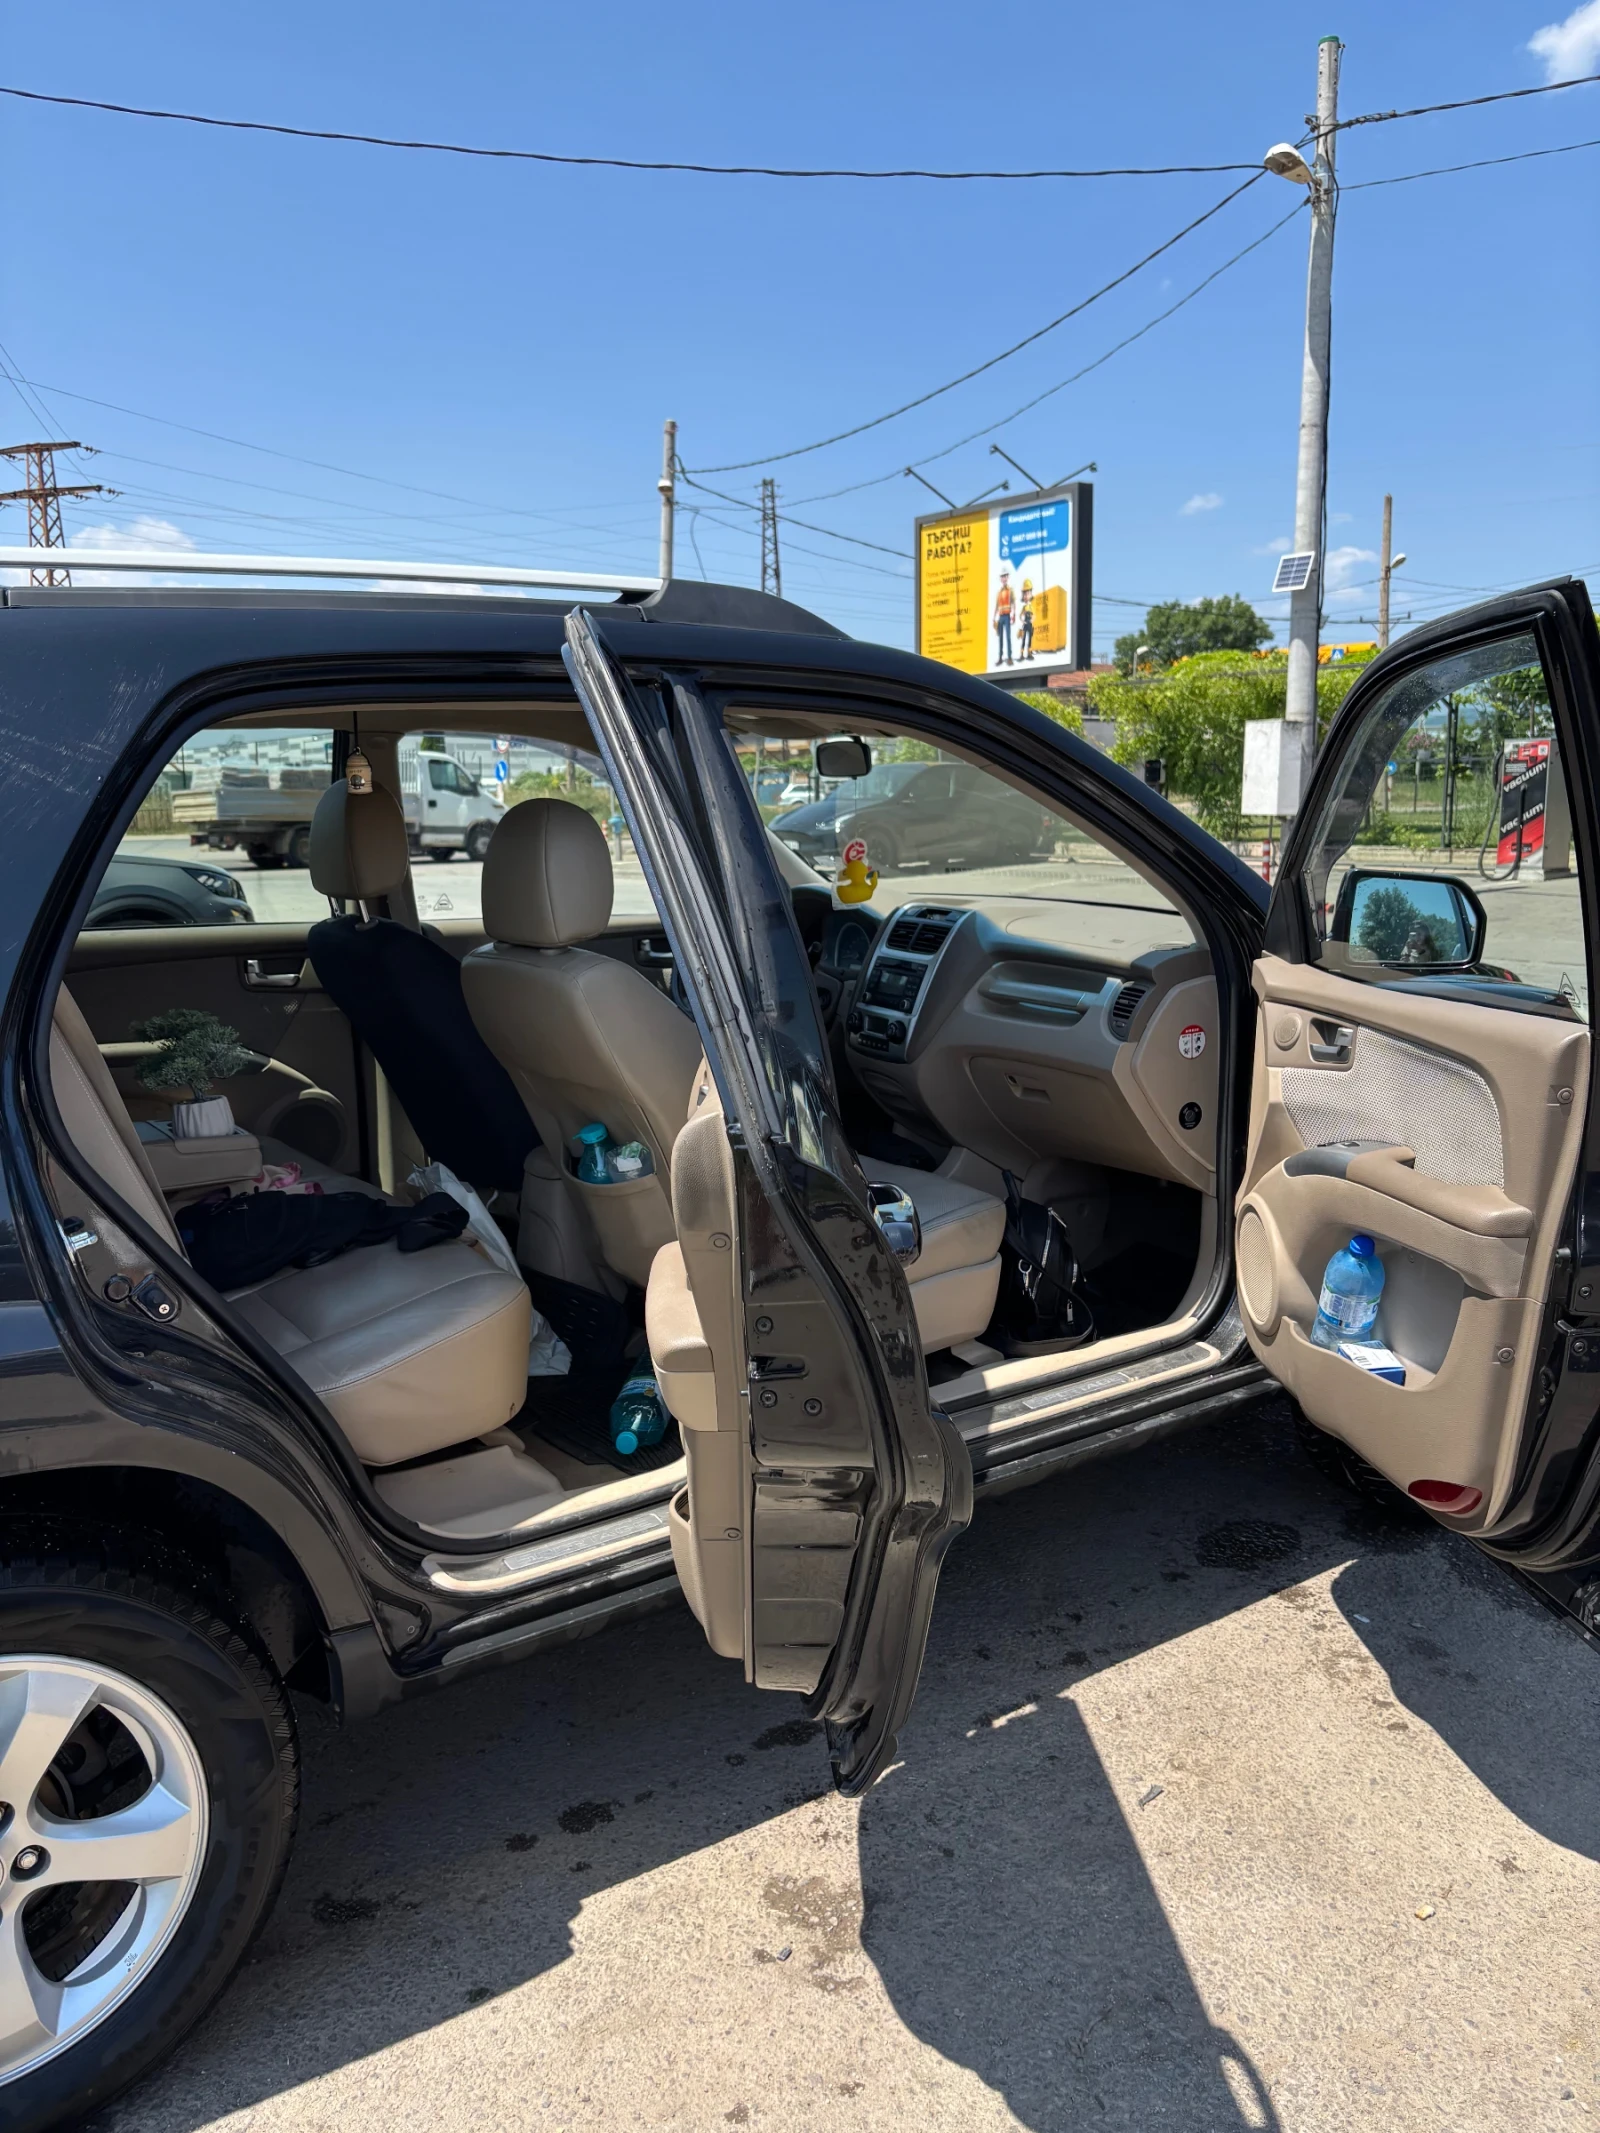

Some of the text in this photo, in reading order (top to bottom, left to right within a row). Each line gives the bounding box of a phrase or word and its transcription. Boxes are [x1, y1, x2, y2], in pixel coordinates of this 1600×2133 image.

[926, 525, 971, 545] ТЪРСИШ
[926, 541, 972, 561] РАБОТА?
[1503, 762, 1546, 793] vacuum
[1500, 803, 1543, 834] vacum
